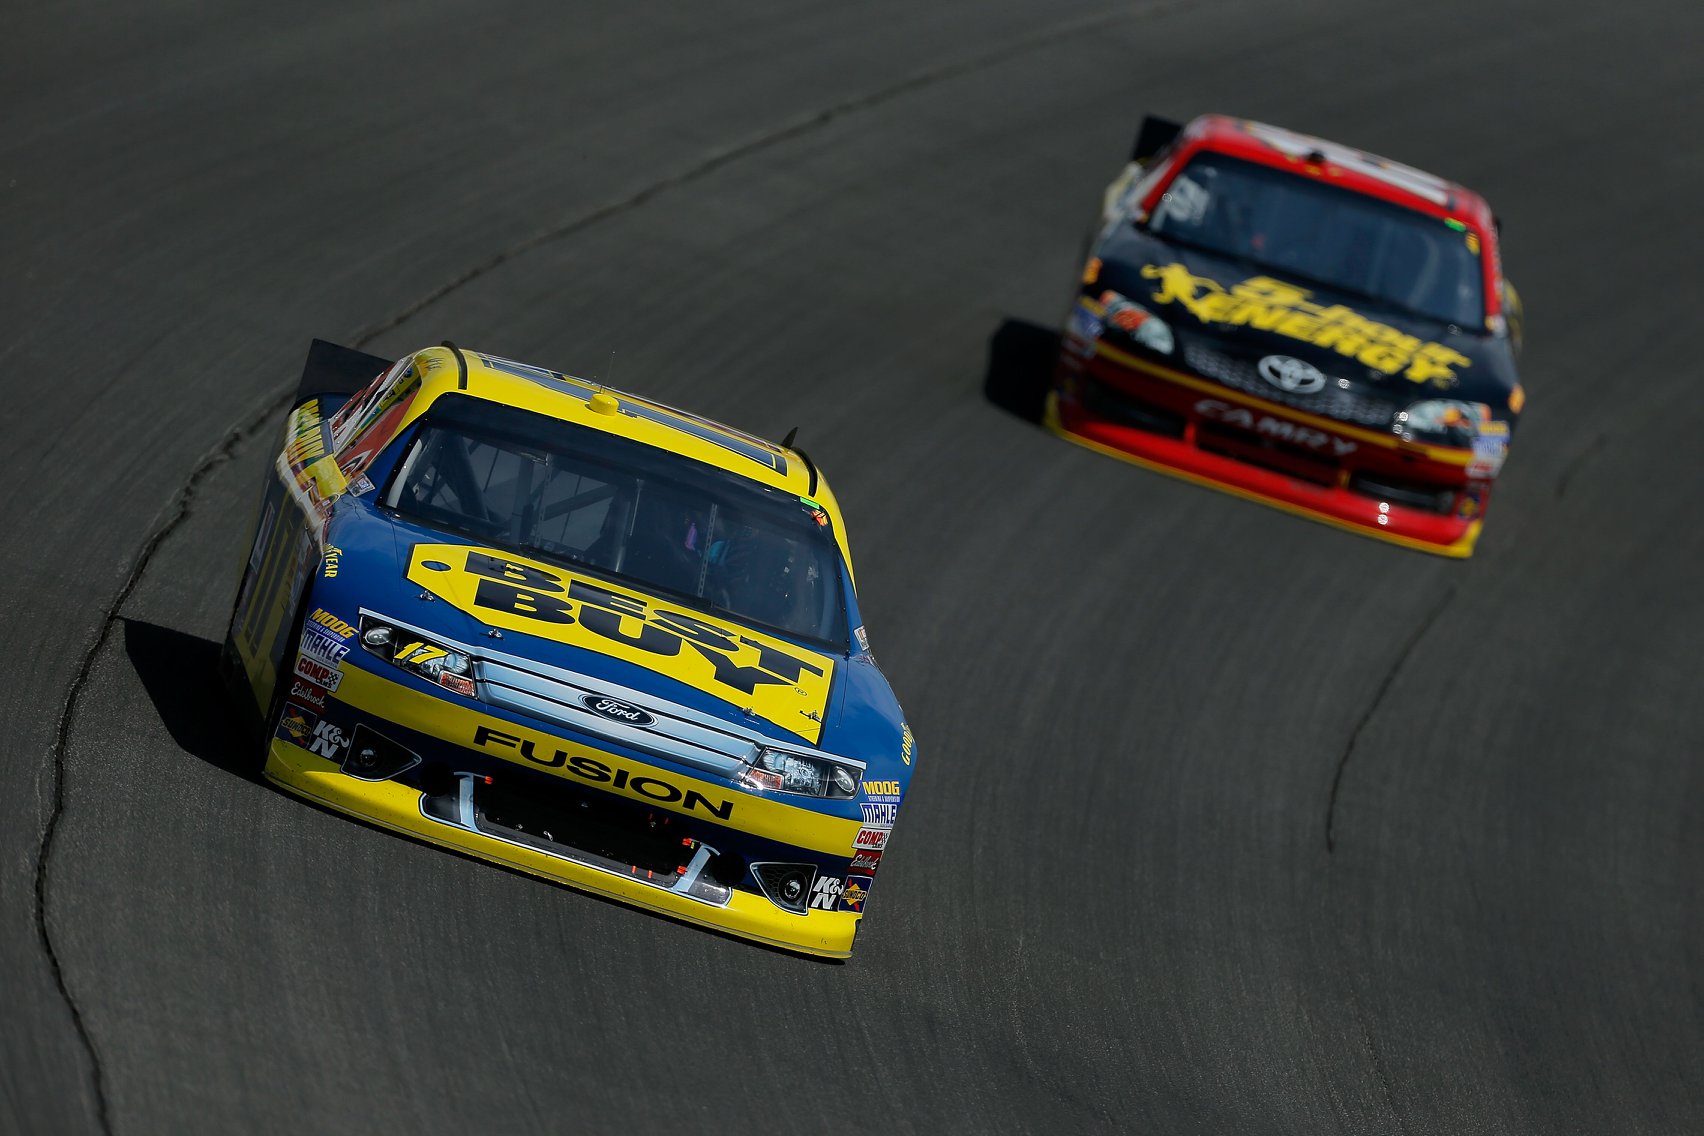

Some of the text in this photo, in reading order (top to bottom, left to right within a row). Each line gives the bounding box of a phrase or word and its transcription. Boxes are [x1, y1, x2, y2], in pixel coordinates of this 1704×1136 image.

[1199, 295, 1457, 384] ENERGY
[1194, 400, 1357, 455] CAMRY
[310, 608, 359, 638] MOOG
[464, 550, 823, 684] BEST
[300, 628, 348, 664] MAHLE
[473, 578, 797, 695] BUY
[394, 642, 449, 664] 17
[298, 658, 330, 681] COMP
[291, 682, 326, 709] Edelbrock
[595, 697, 640, 721] Ford
[281, 719, 311, 736] SUNOCO
[473, 726, 734, 821] FUSION
[862, 781, 900, 795] MOOG
[860, 803, 897, 825] MAHLE
[856, 830, 884, 845] COMP
[842, 889, 868, 902] SUNOCO
